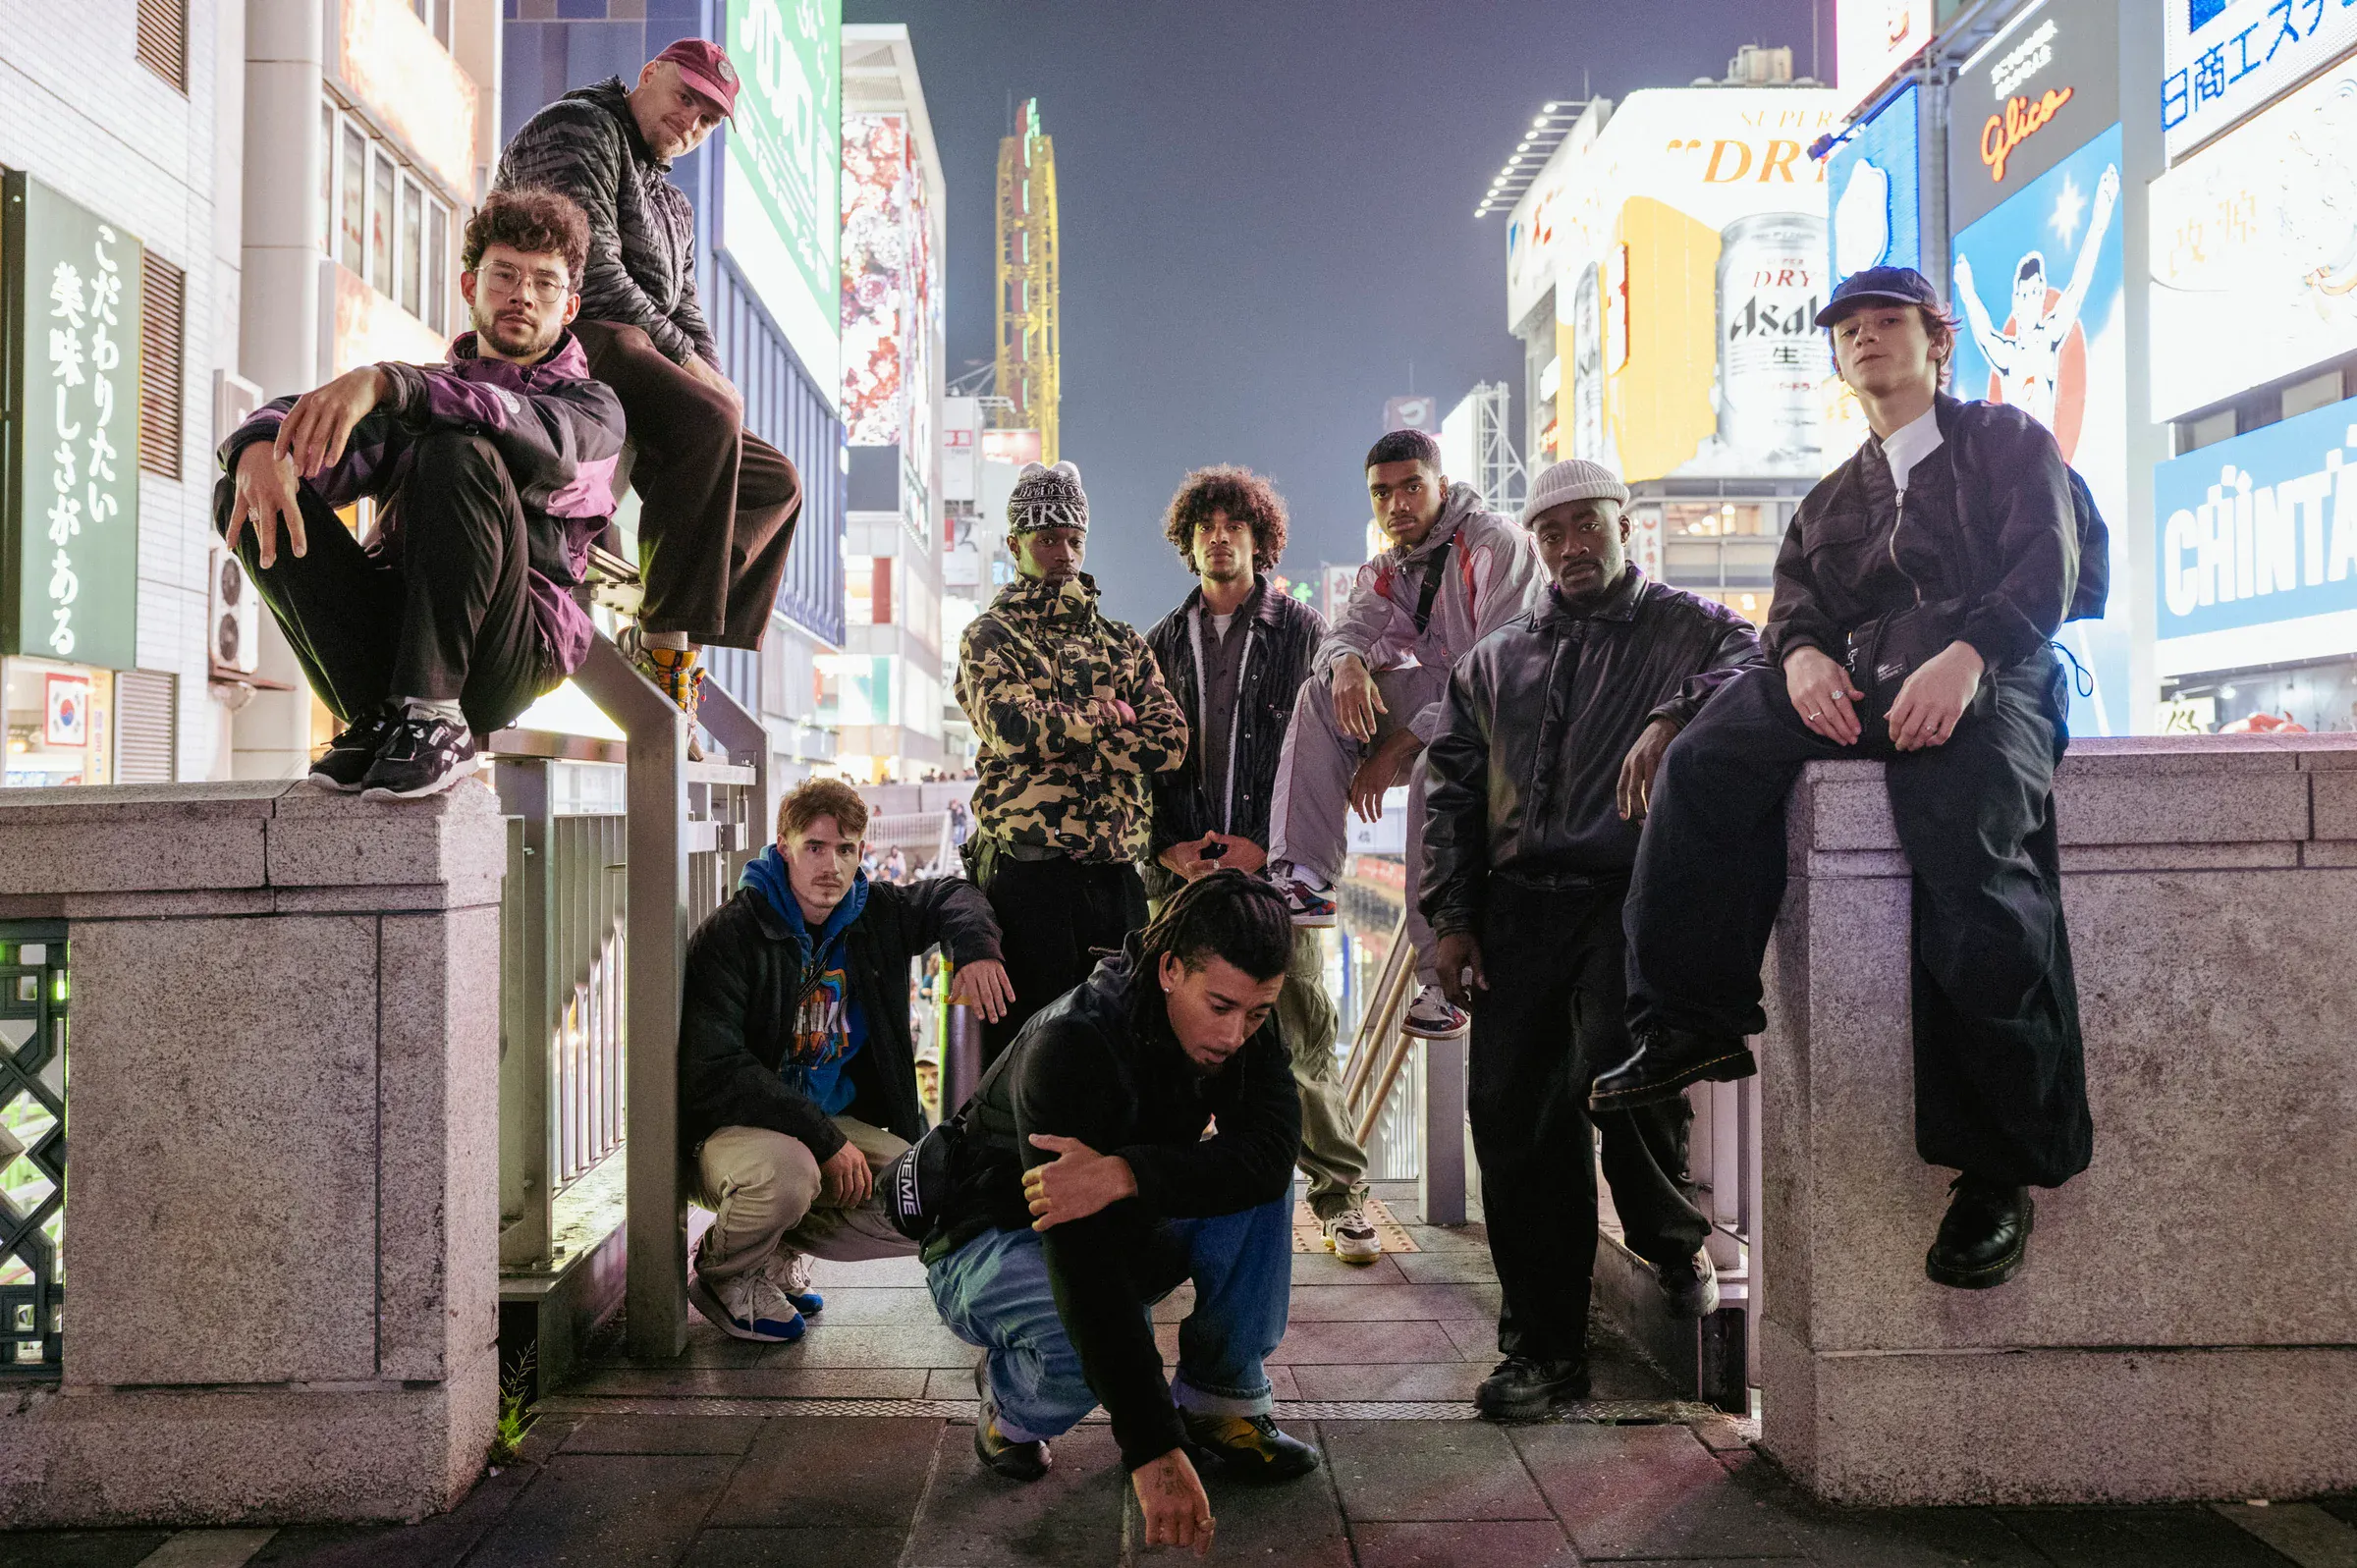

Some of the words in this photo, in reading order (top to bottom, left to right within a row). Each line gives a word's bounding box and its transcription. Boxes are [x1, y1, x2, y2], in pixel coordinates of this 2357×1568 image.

[1981, 86, 2073, 182] Glico
[1754, 270, 1810, 287] DRY
[88, 225, 122, 523] こだわりたい
[1774, 346, 1800, 364] 生
[49, 260, 85, 656] 美味しさがある
[901, 1145, 917, 1216] REME
